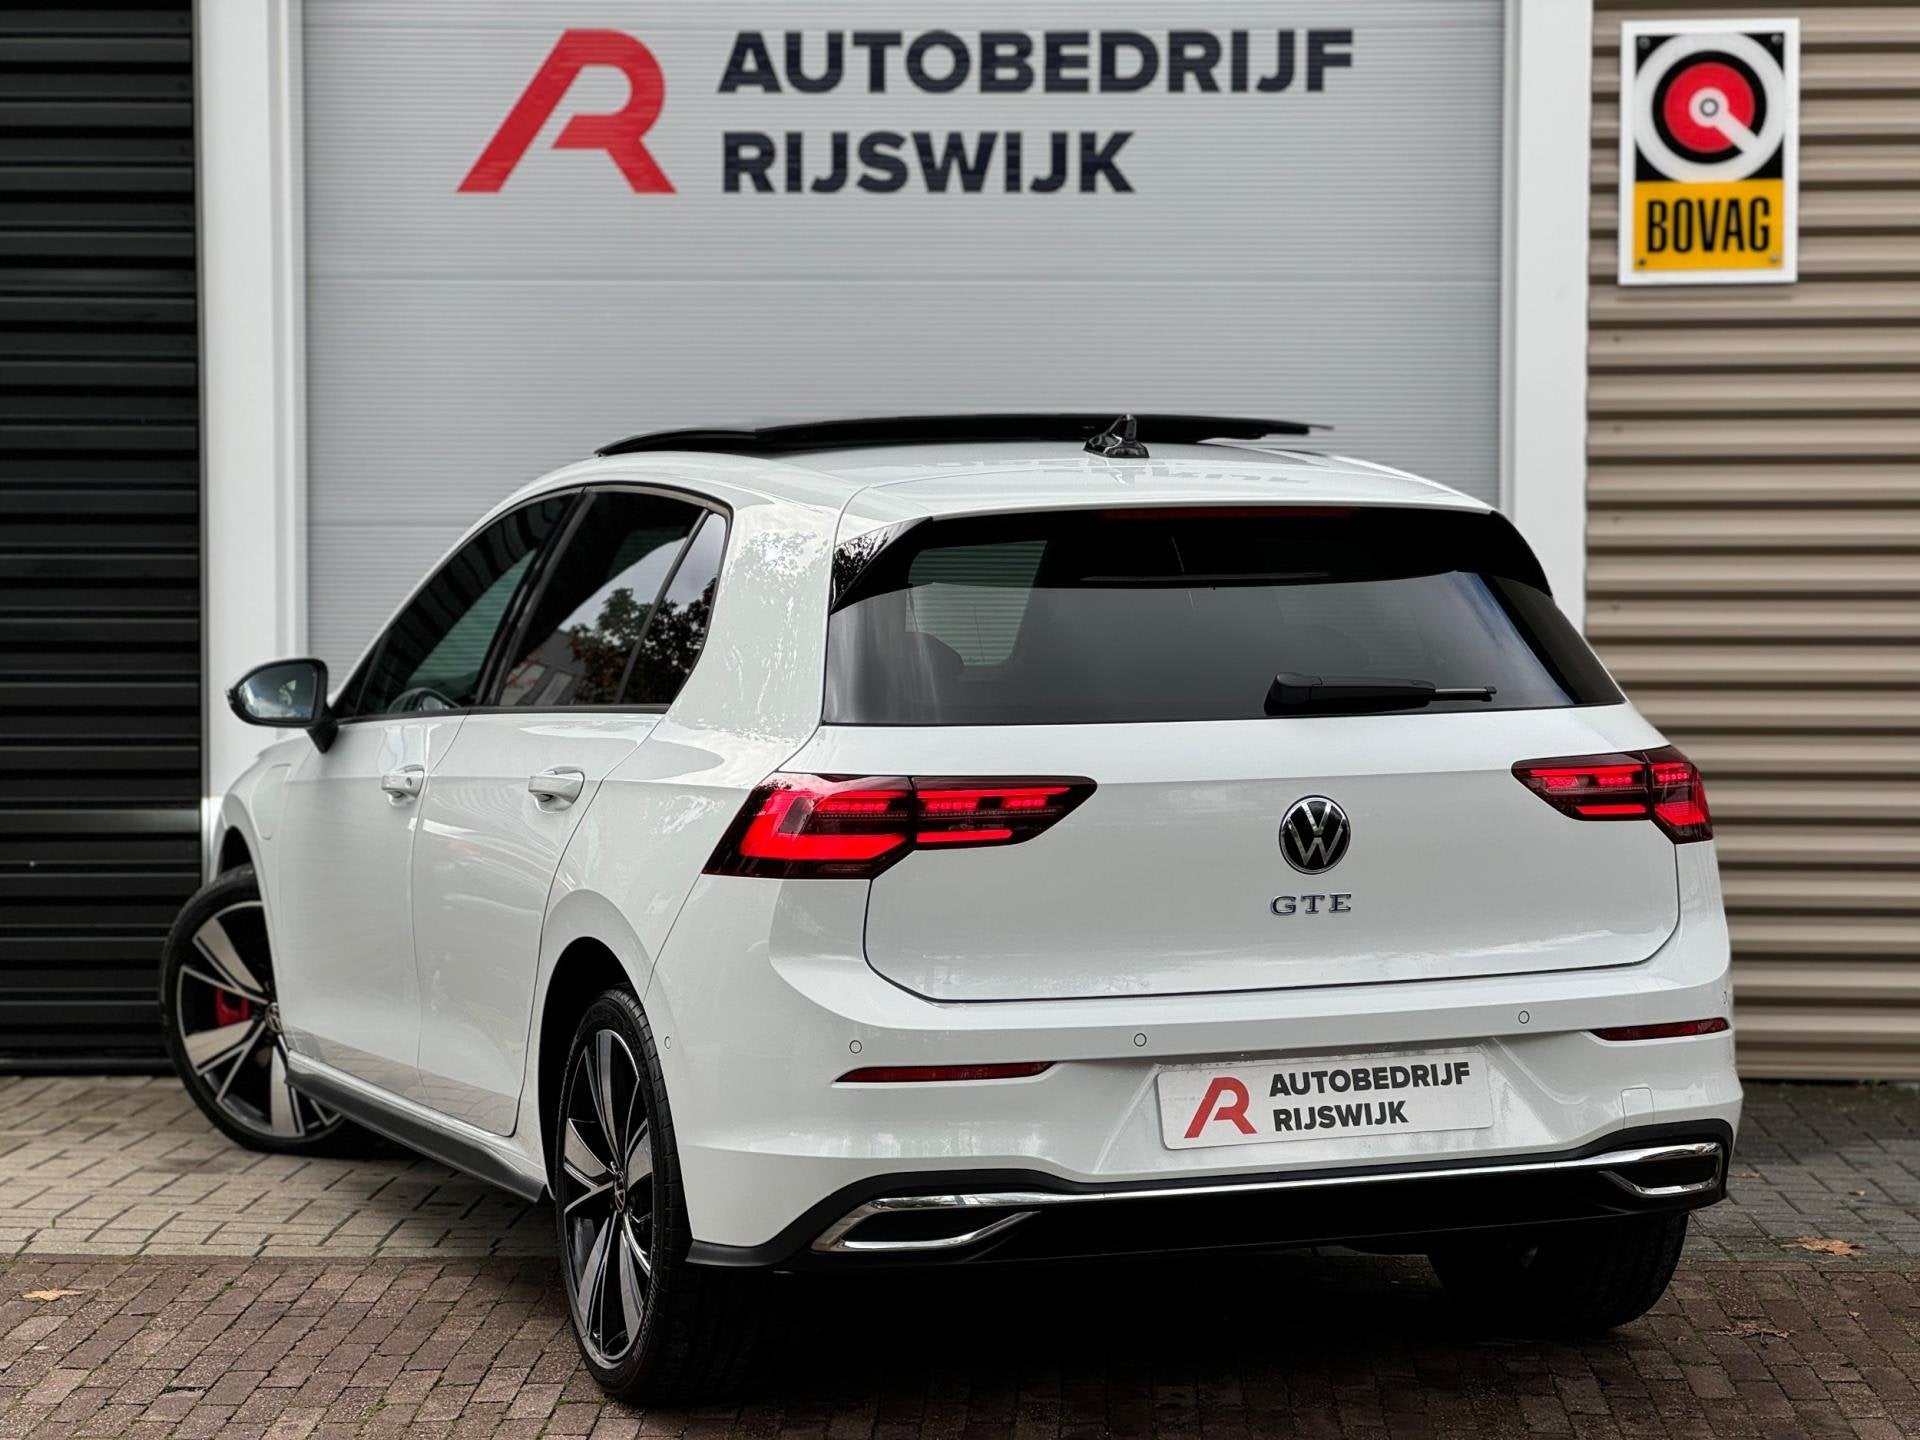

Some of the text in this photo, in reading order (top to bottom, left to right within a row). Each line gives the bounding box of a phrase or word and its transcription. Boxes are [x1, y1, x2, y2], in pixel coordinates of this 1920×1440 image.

[717, 28, 1354, 94] AUTOBEDRIJF
[722, 131, 1136, 194] RIJSWIJK
[1647, 197, 1770, 253] BOVAG
[1270, 892, 1352, 916] GTE
[1268, 1061, 1471, 1098] AUTOBEDRIJF
[1272, 1100, 1410, 1132] RIJSWIJK
